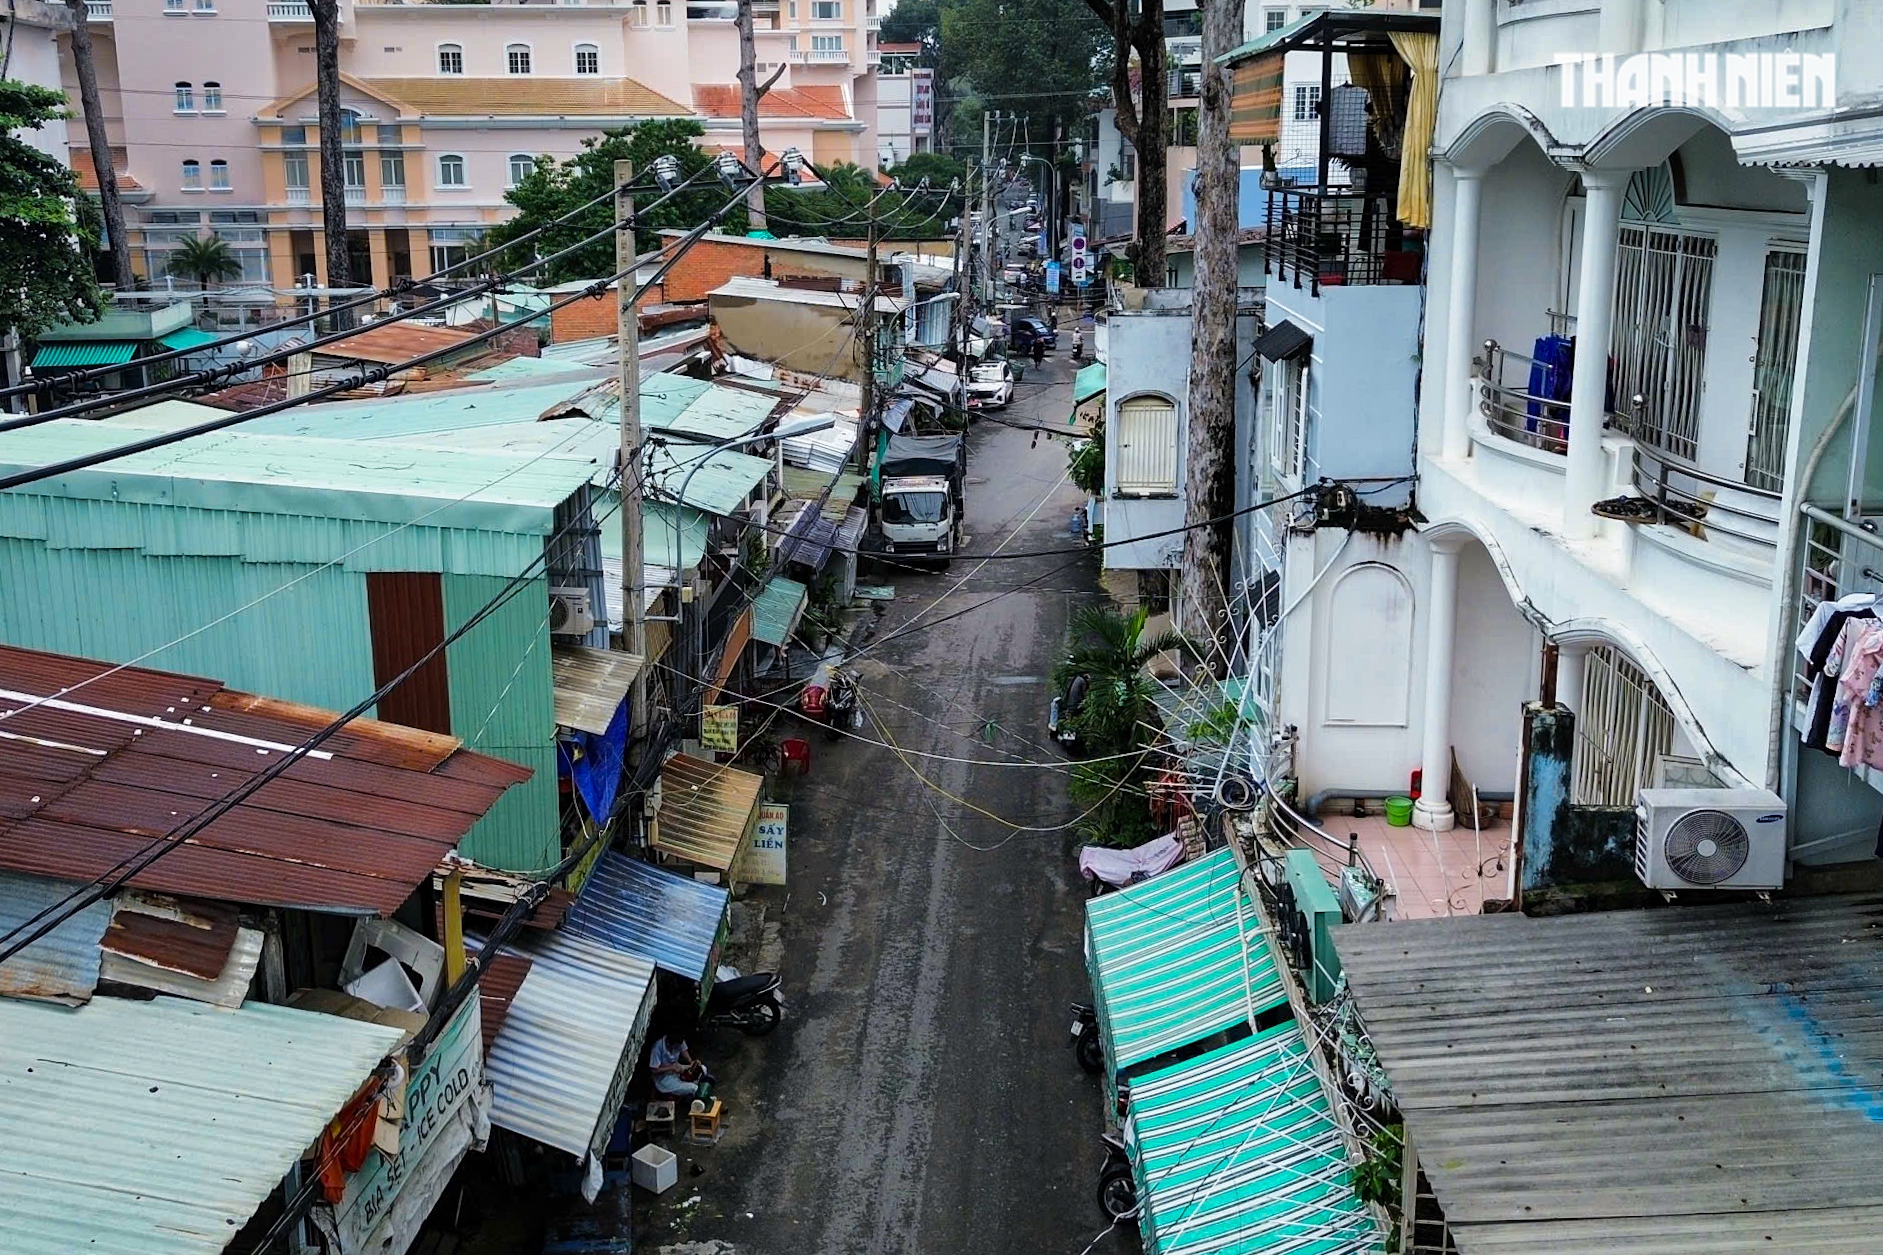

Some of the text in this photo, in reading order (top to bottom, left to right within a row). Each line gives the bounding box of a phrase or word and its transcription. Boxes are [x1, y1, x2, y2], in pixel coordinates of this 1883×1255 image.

[758, 823, 784, 835] SẤY
[364, 1185, 384, 1225] BIA
[417, 1108, 436, 1145] ICE
[437, 1068, 469, 1115] COLD
